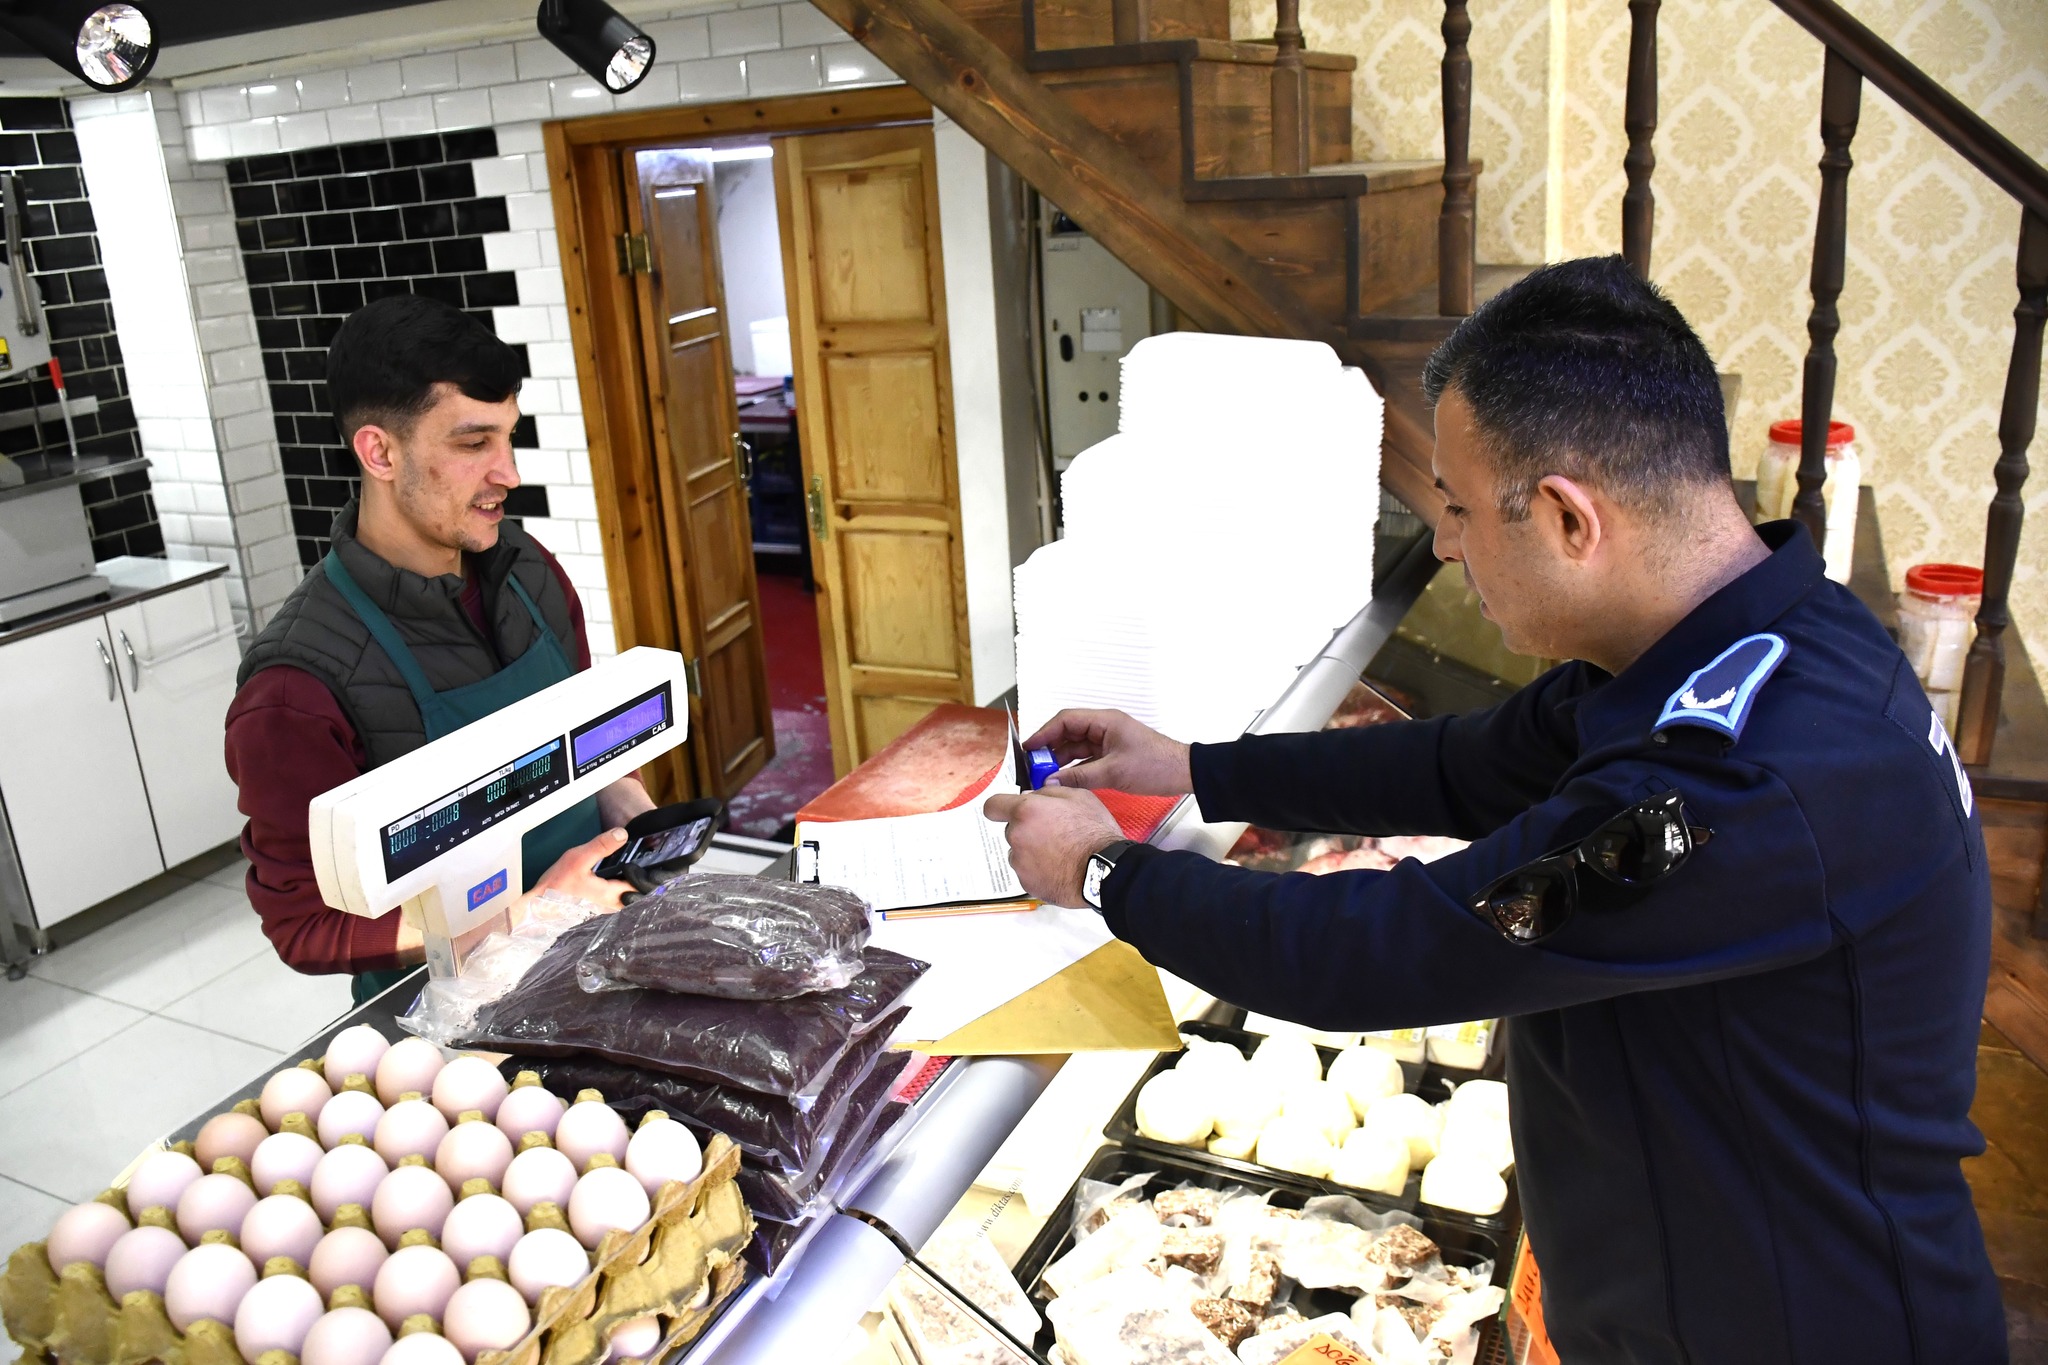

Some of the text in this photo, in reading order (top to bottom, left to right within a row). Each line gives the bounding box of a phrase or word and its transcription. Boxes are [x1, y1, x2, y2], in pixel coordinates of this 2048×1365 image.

[652, 722, 667, 735] CAS
[499, 766, 512, 776] TL/kg
[414, 813, 422, 821] kg
[473, 876, 503, 904] CAS
